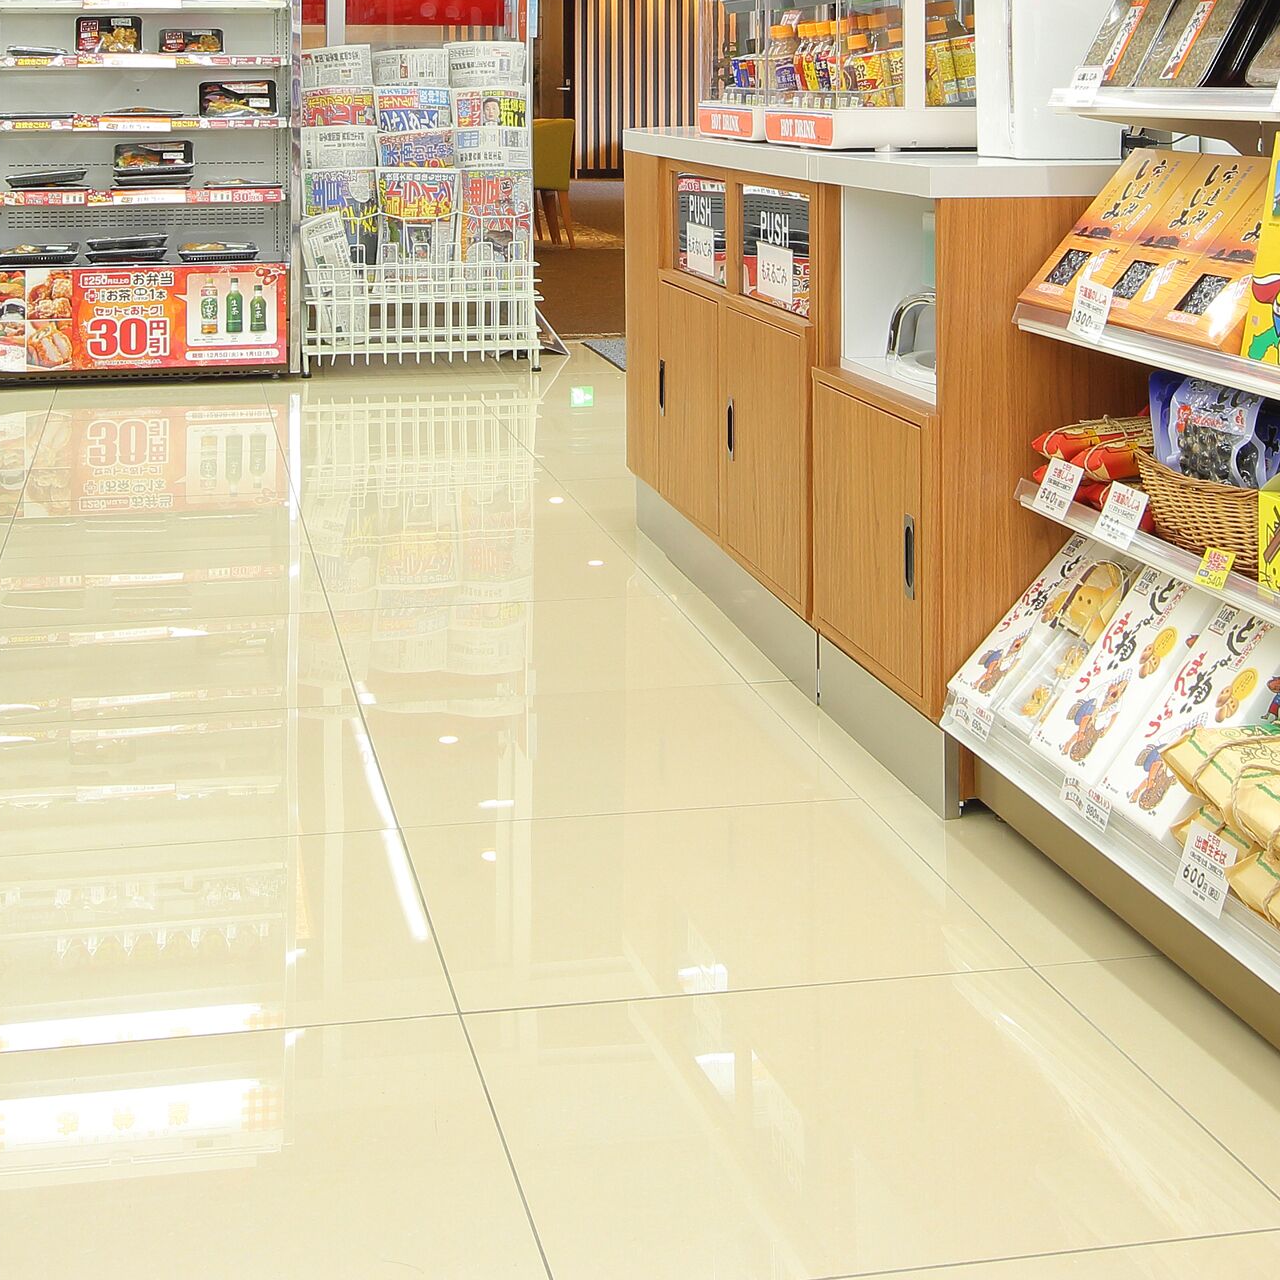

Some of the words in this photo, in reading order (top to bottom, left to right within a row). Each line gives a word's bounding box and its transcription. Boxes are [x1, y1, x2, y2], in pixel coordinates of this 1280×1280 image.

[711, 114, 721, 130] HOT
[722, 114, 740, 132] DRINK
[780, 119, 794, 137] HOT
[794, 119, 816, 139] DRINK
[688, 195, 712, 227] PUSH
[760, 211, 789, 247] PUSH
[132, 272, 173, 285] お弁当
[761, 263, 788, 287] もえるごみ
[95, 306, 164, 317] セットでおトク！
